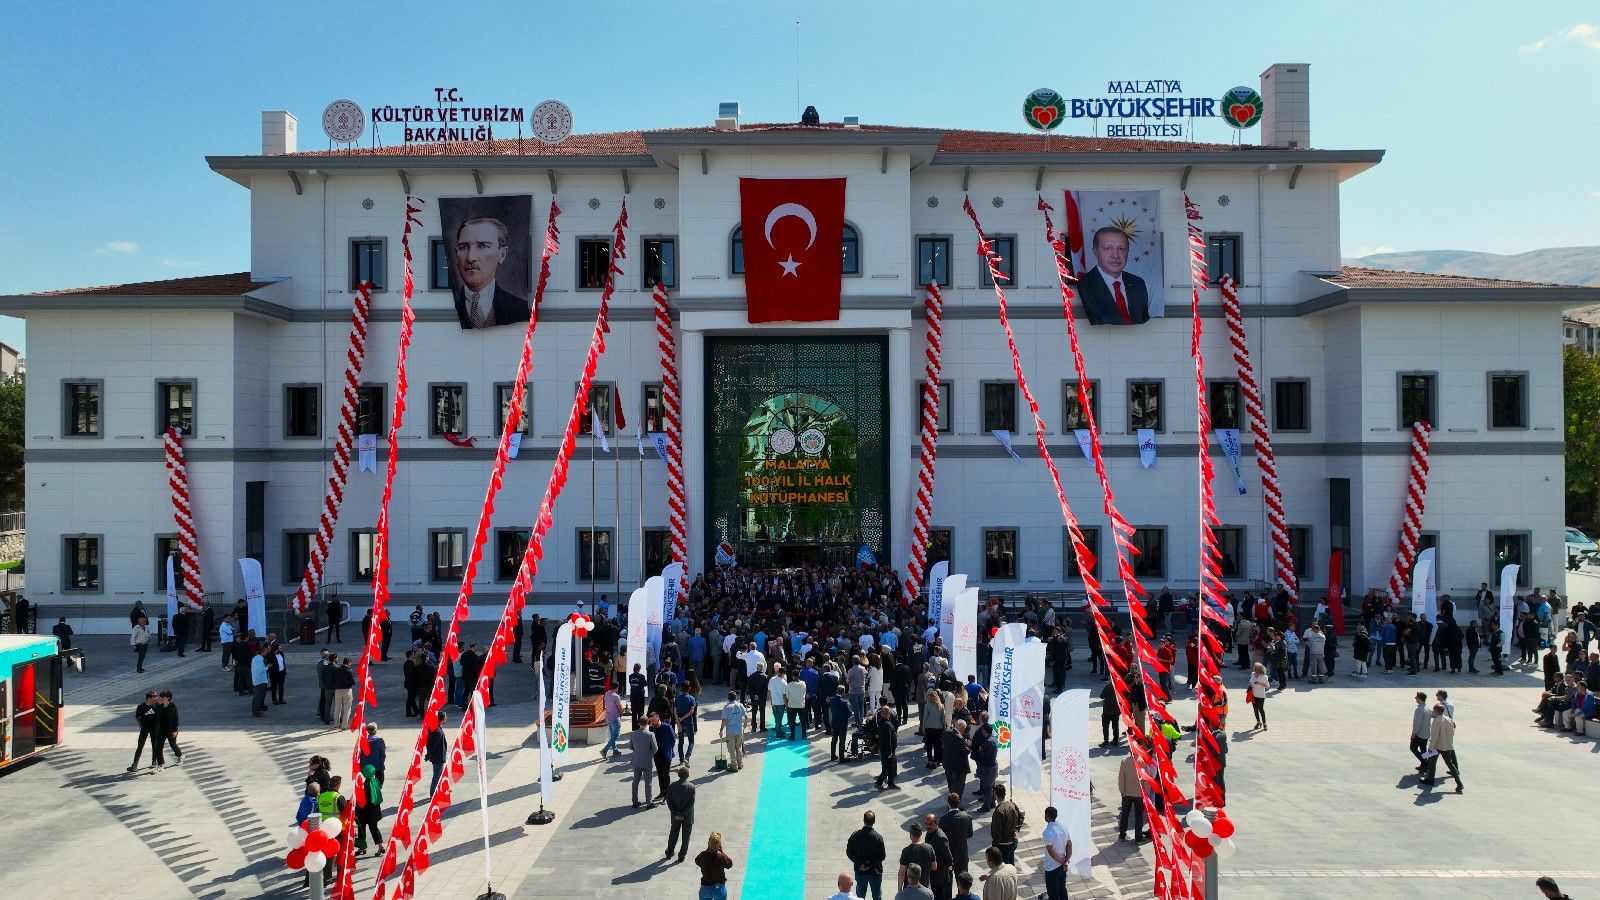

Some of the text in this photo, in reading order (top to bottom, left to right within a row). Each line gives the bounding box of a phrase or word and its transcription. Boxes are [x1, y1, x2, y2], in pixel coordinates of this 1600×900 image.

[1108, 80, 1182, 93] MALATYA
[434, 87, 464, 102] T.C.
[372, 105, 434, 122] KÜLTÜR
[438, 107, 458, 122] VE
[461, 105, 524, 122] TURİZM
[404, 125, 492, 142] BAKANLIĞI
[765, 458, 830, 470] MALATYA
[814, 474, 852, 487] HALK
[993, 662, 1002, 699] MALATYA
